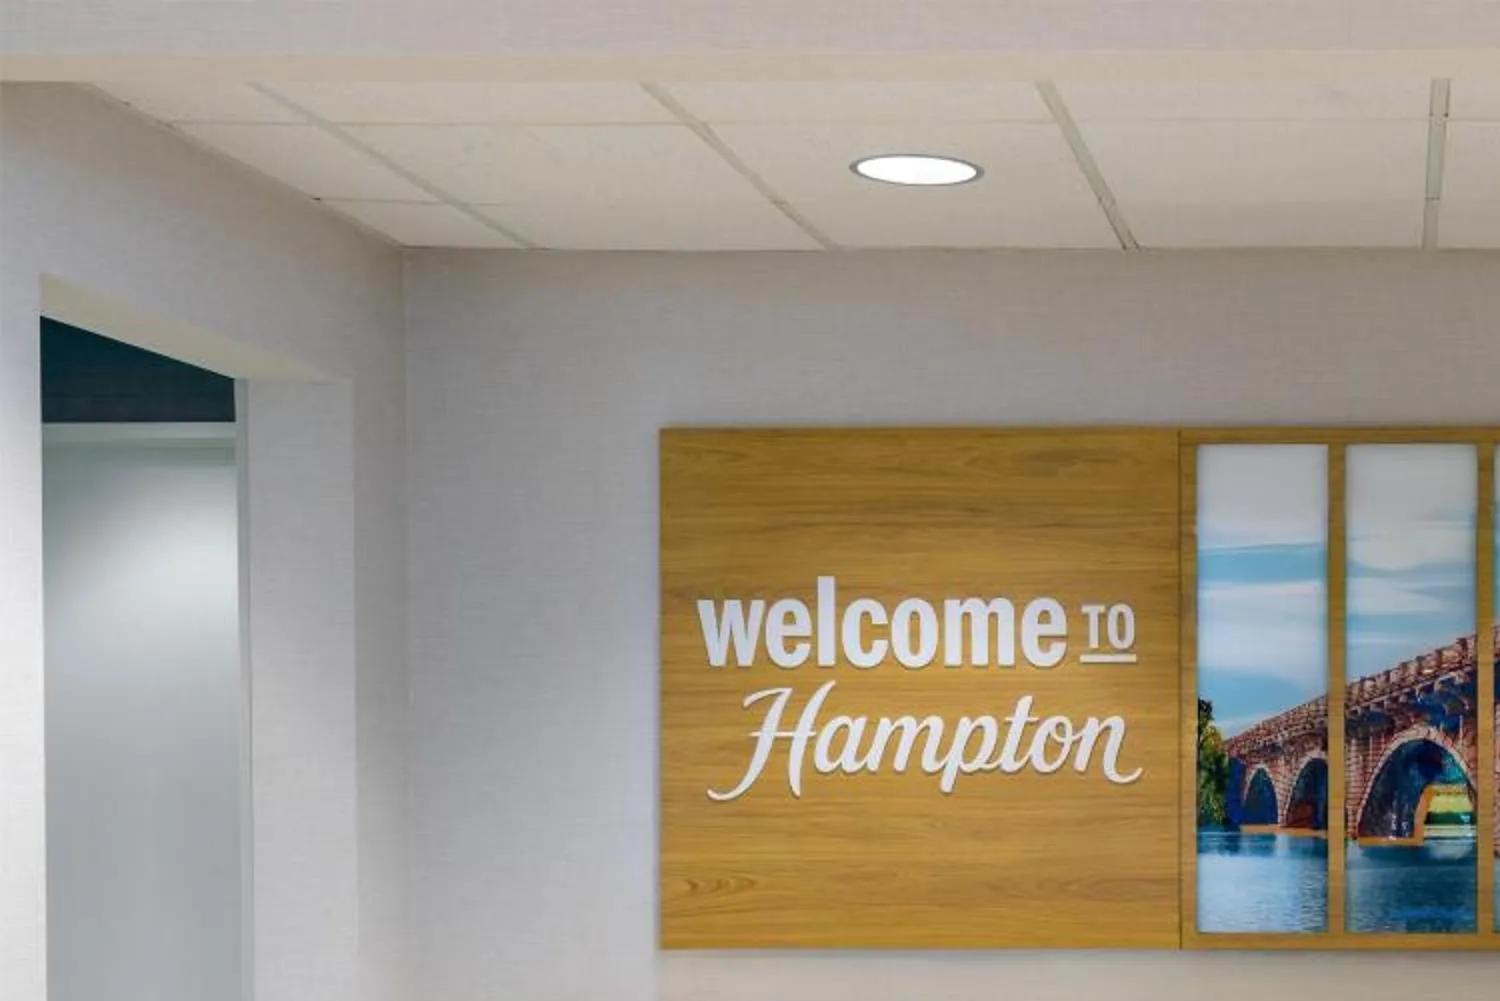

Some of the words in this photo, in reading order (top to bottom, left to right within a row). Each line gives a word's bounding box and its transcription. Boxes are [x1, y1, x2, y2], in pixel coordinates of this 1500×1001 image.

[697, 575, 1068, 668] welcome
[1081, 602, 1136, 651] TO
[707, 679, 1143, 801] Hampton
